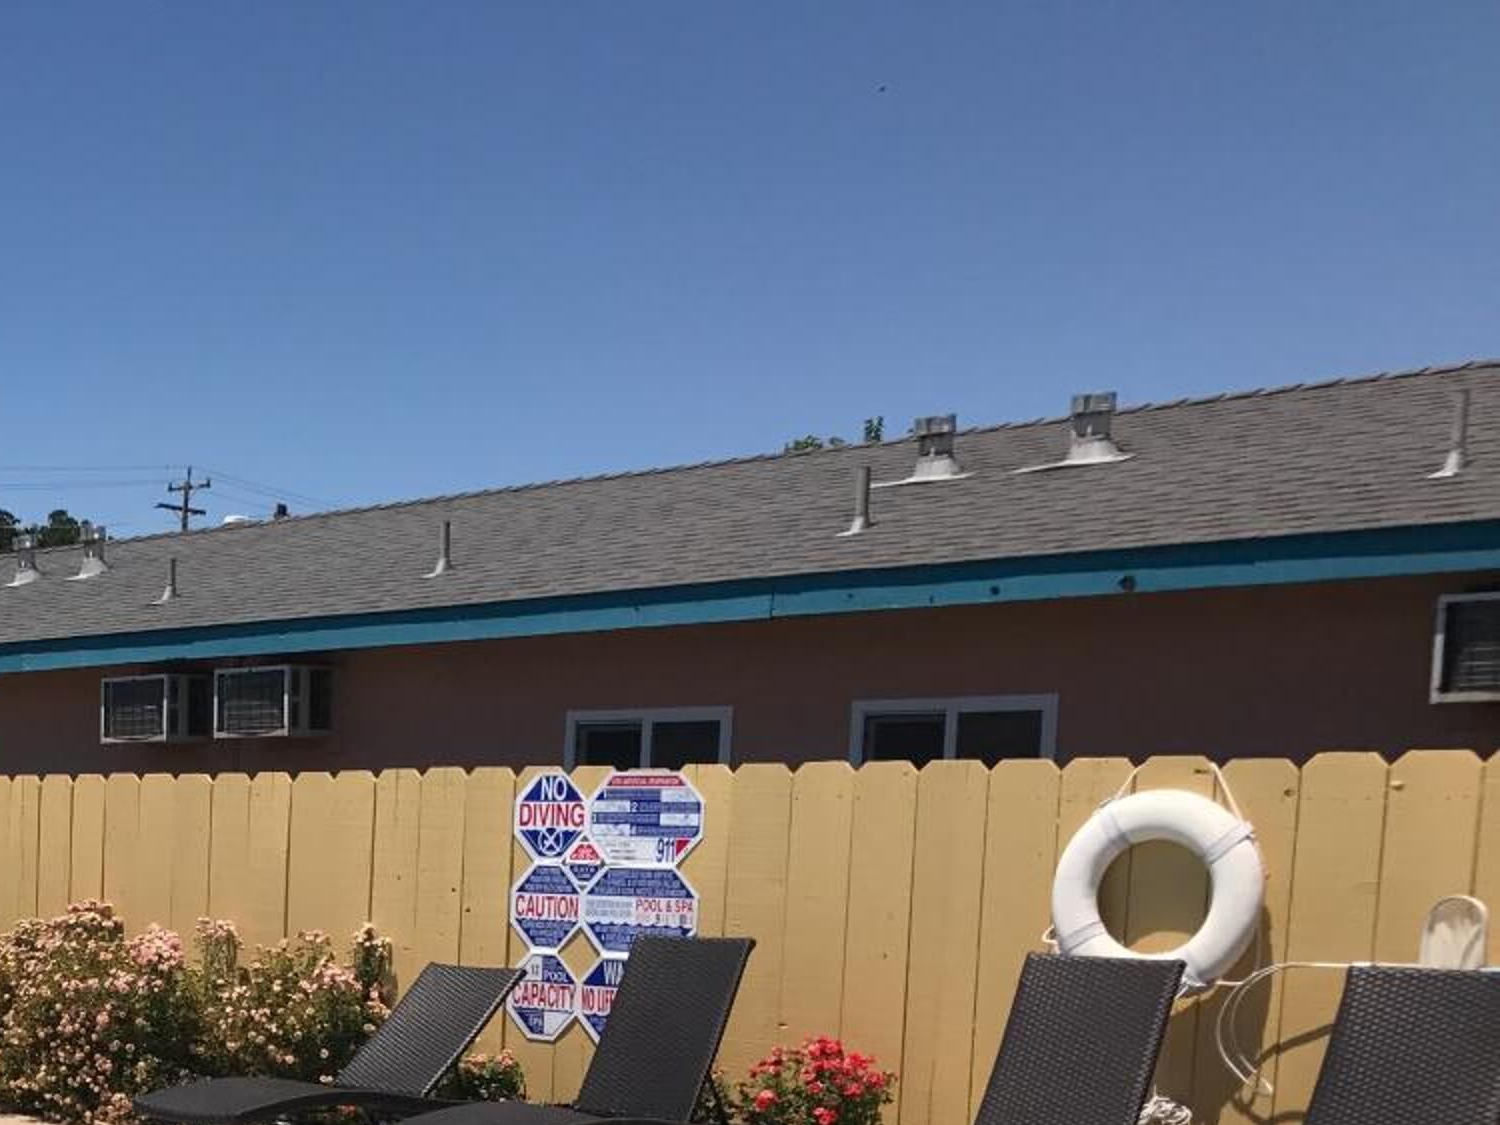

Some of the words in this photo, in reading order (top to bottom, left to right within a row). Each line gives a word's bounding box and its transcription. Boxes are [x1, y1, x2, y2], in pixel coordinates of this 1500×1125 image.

[540, 776, 567, 801] NO
[519, 803, 585, 827] DIVING
[656, 837, 675, 863] 911
[516, 894, 579, 918] CAUTION
[636, 898, 662, 912] POOL
[675, 899, 693, 913] SPA
[544, 969, 568, 982] POOL
[513, 983, 574, 1010] CAPACITY
[582, 987, 594, 1011] NO
